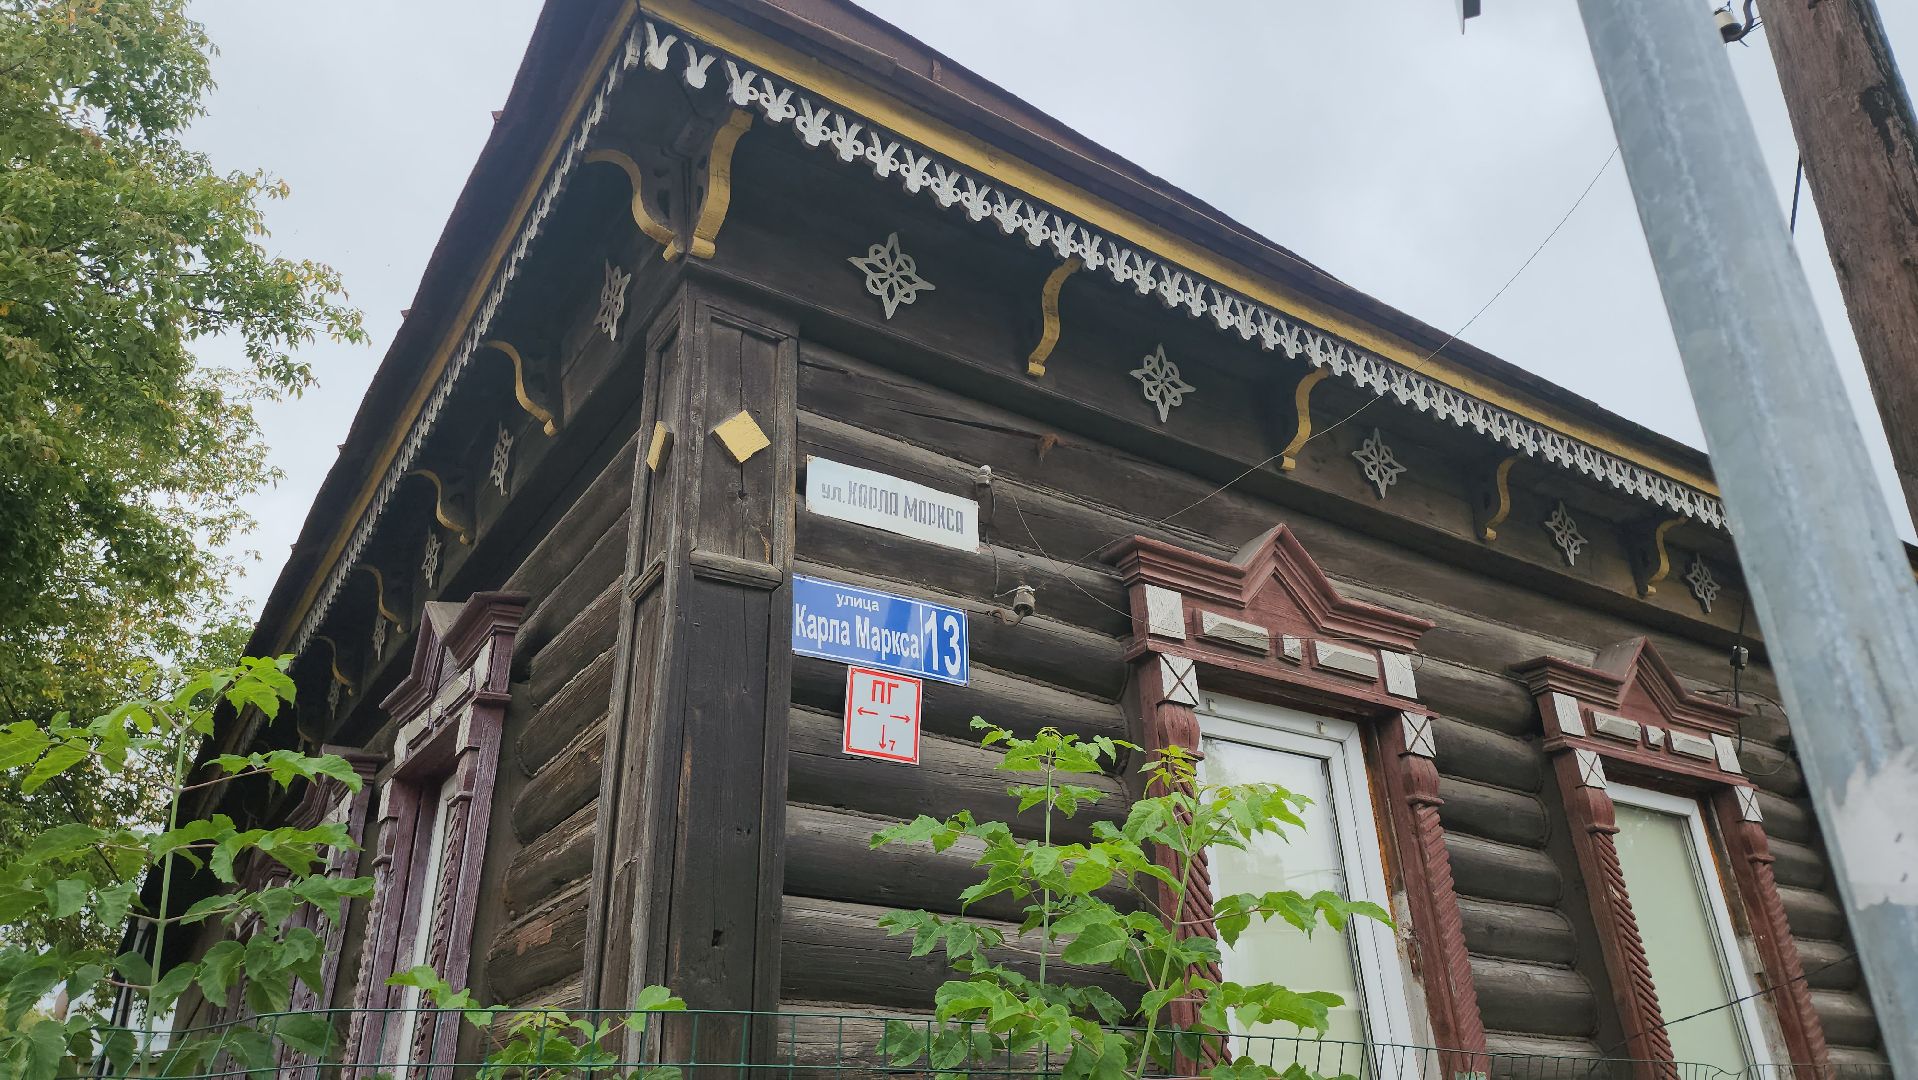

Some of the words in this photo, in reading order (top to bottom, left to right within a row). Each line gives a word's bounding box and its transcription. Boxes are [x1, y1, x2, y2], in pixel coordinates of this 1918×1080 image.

[822, 483, 845, 503] ул.
[848, 481, 899, 517] КАРЛА
[904, 495, 964, 534] МАРКСА
[836, 594, 880, 612] улица
[795, 603, 850, 649] Карла
[855, 615, 919, 660] Маркса
[925, 611, 961, 676] 13
[872, 680, 899, 704] ПГ
[889, 740, 896, 751] 7
